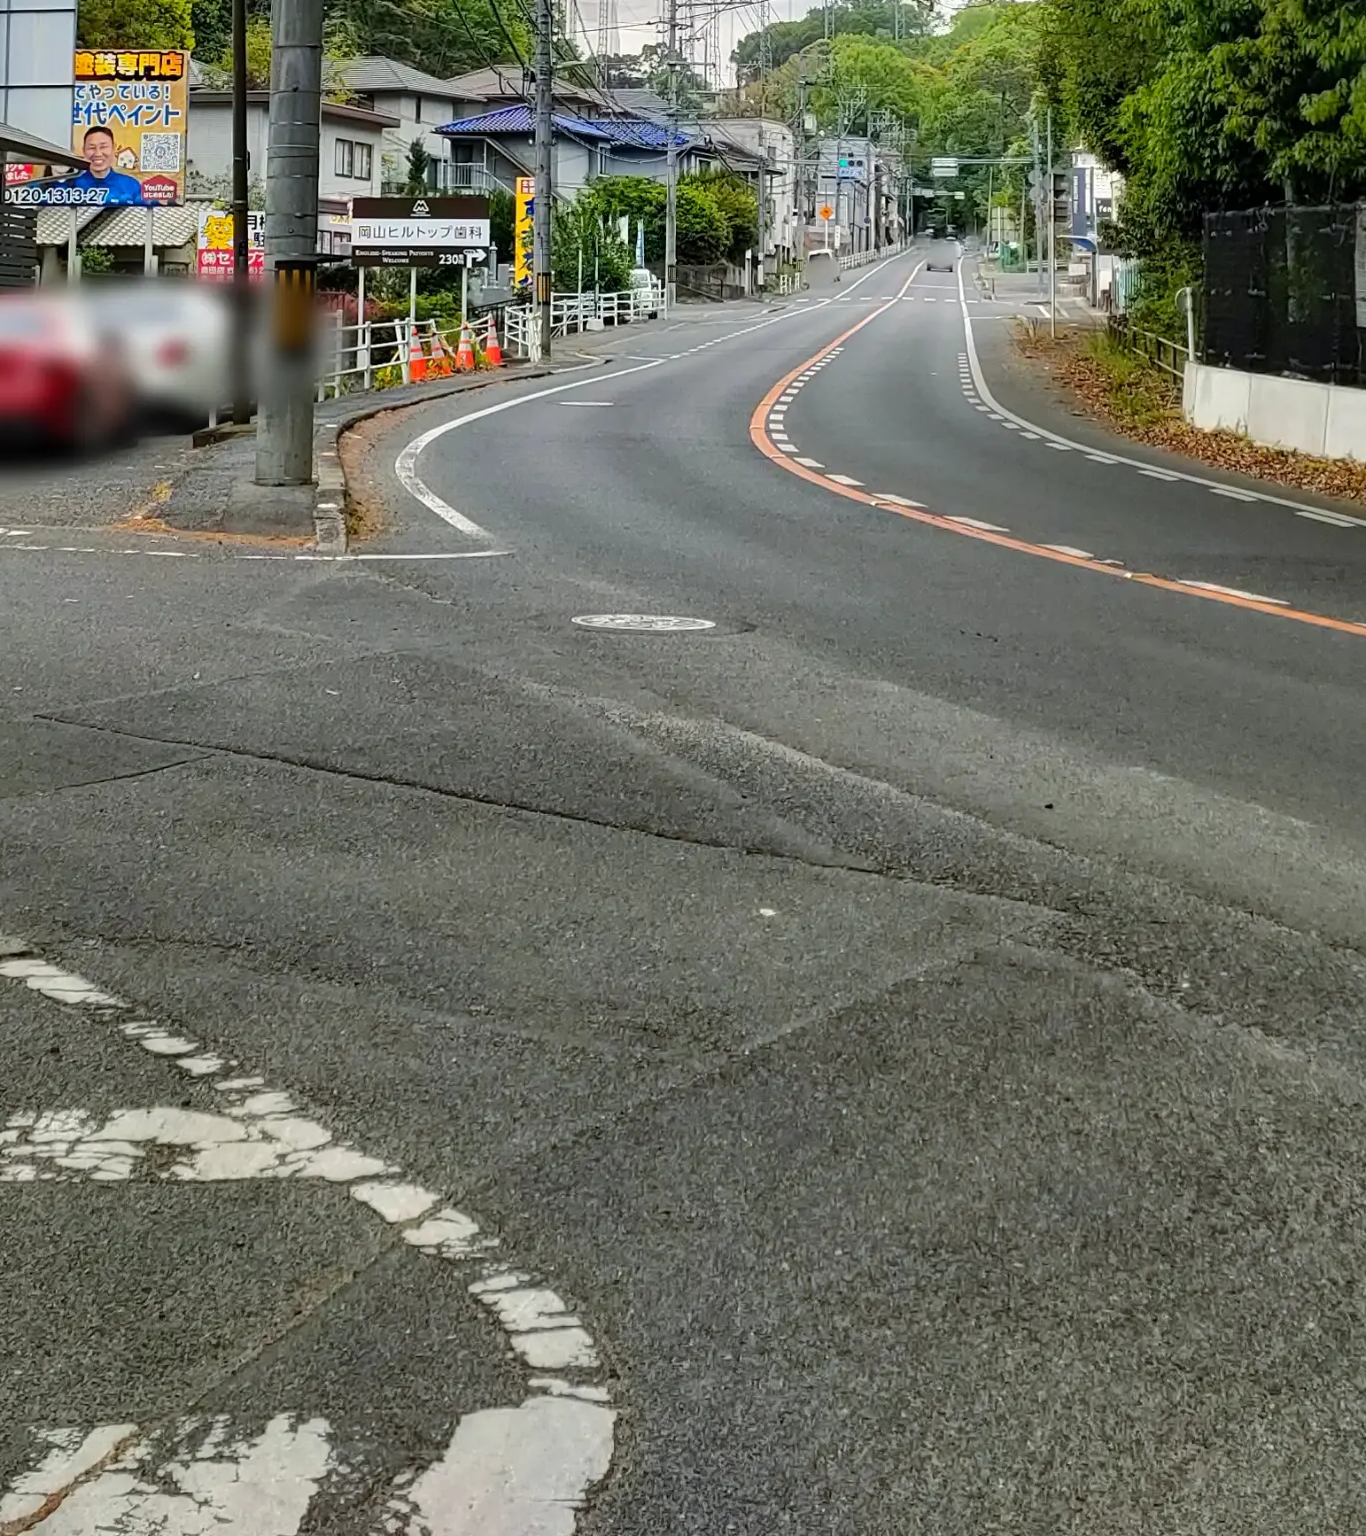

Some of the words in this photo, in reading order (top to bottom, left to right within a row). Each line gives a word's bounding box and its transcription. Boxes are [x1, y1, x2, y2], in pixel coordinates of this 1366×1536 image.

[75, 52, 184, 78] 塗装専門店
[3, 188, 109, 204] 0120-1313-27
[358, 225, 483, 239] 岡山ヒルトップ歯科
